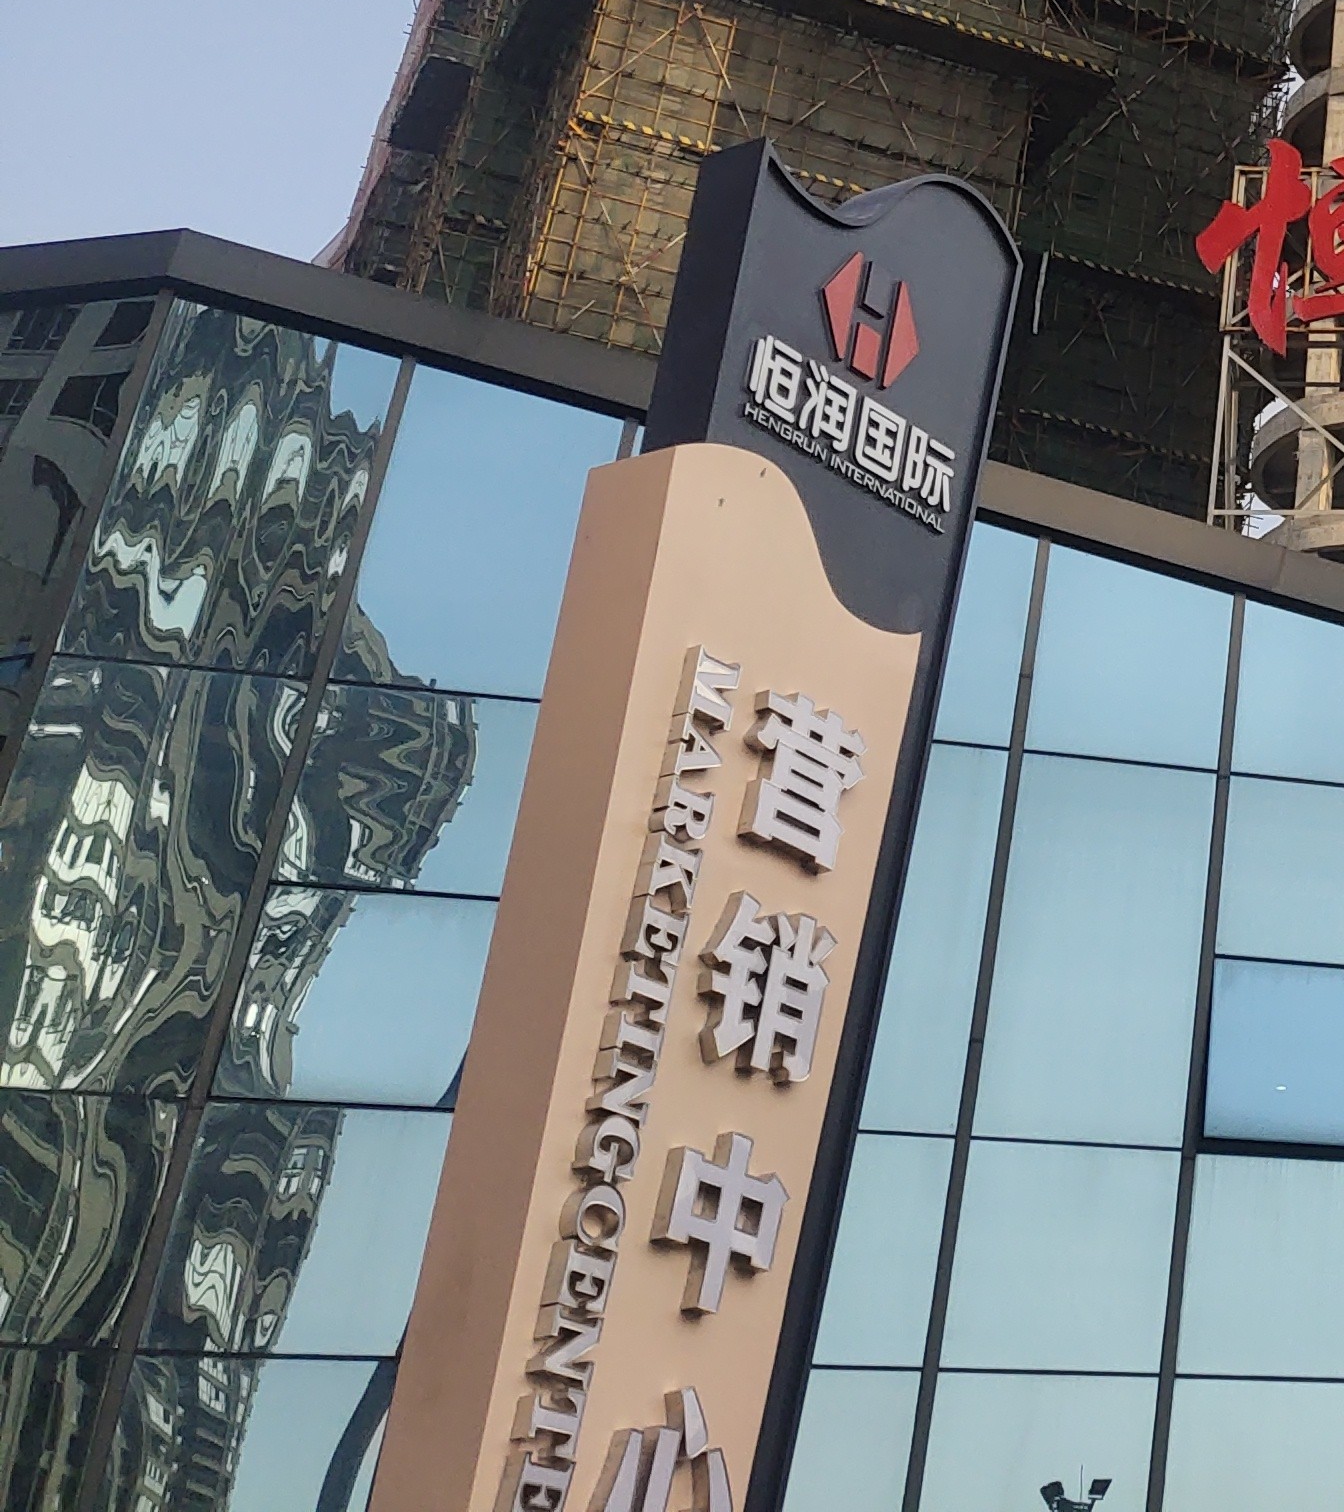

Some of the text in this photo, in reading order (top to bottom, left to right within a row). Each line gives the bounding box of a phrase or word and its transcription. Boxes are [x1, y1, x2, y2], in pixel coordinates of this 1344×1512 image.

[744, 402, 946, 534] HENGRUN INTERNATIONAL
[748, 334, 956, 513] 恒润国际
[596, 692, 868, 1512] 营销中心
